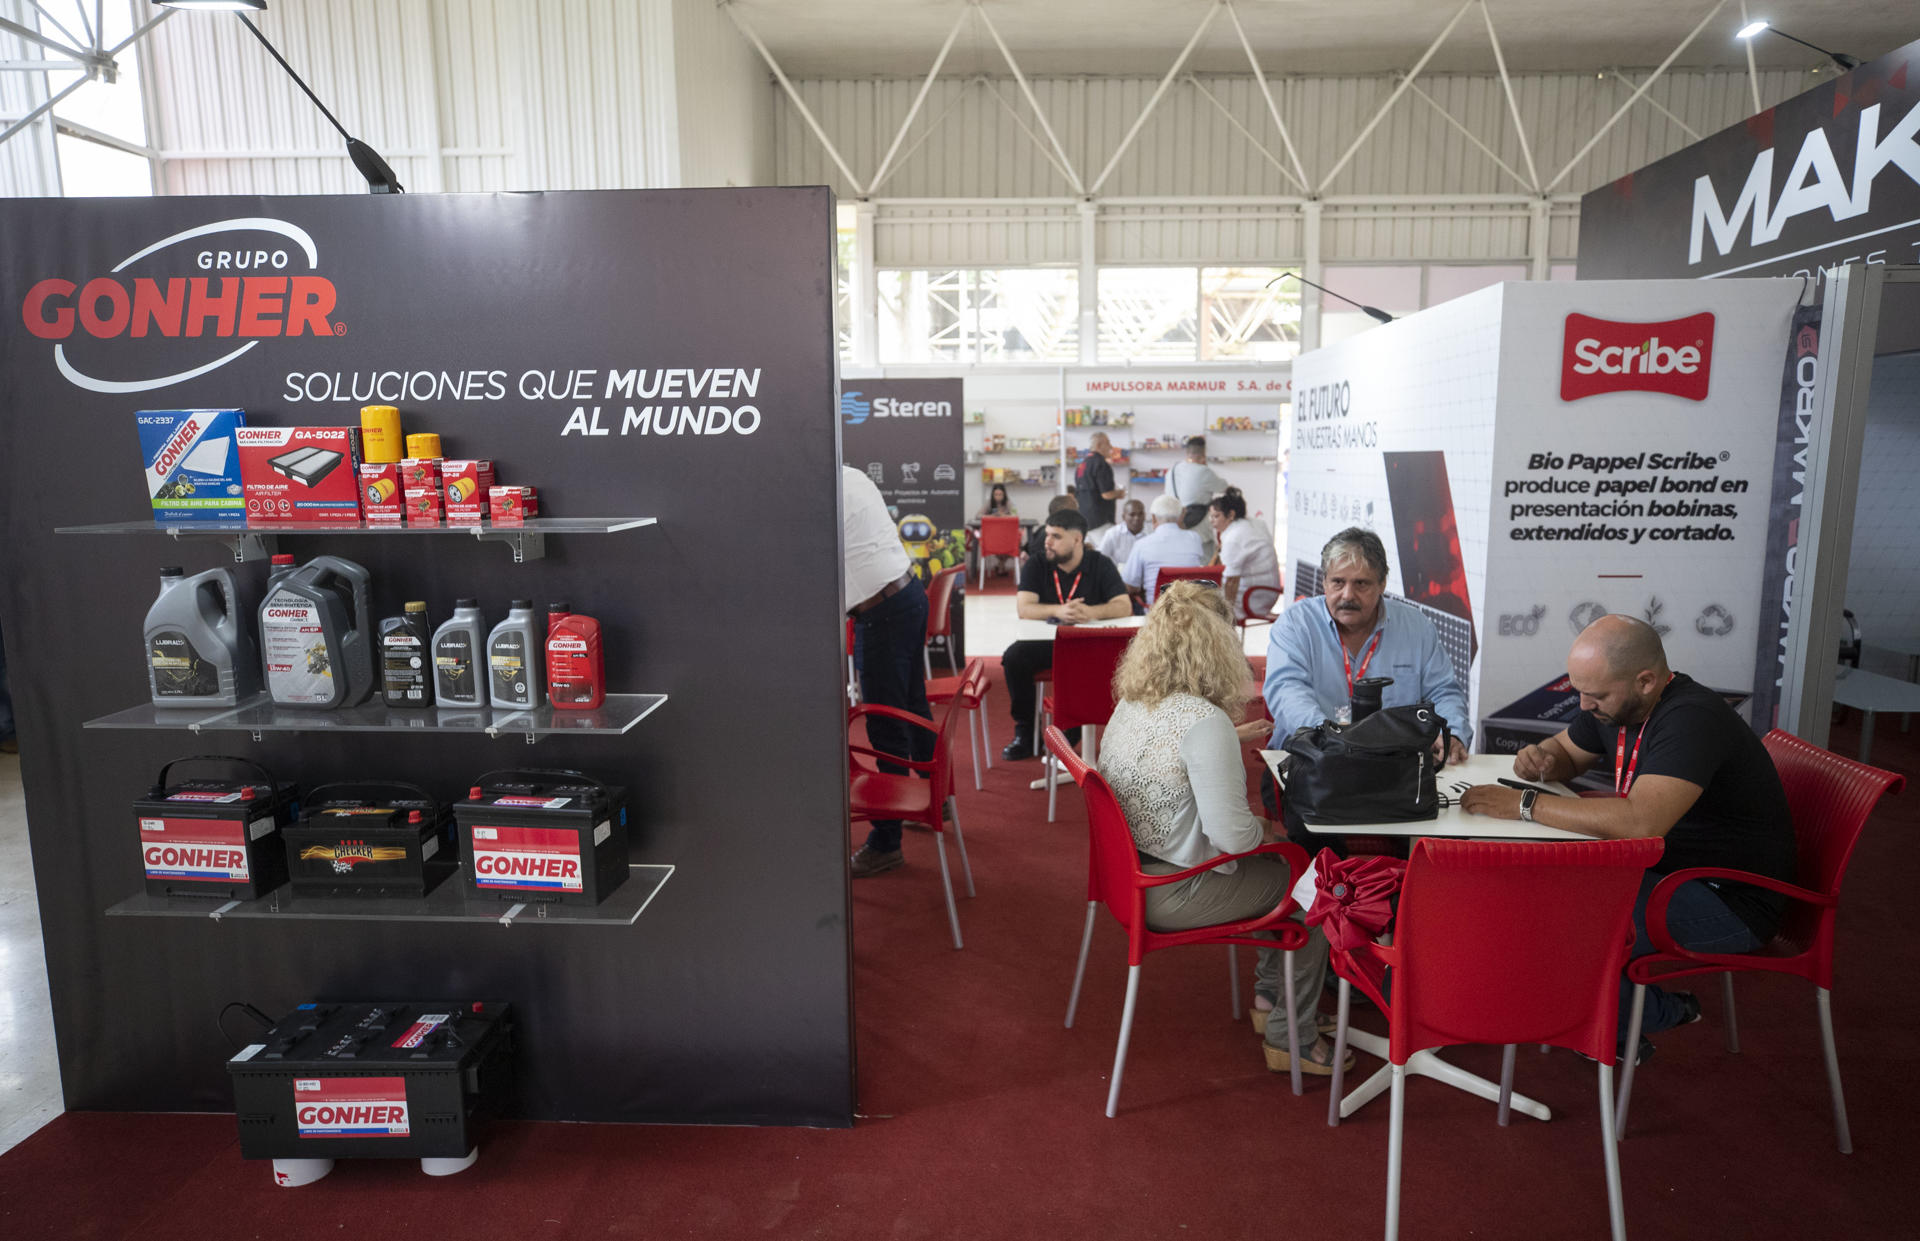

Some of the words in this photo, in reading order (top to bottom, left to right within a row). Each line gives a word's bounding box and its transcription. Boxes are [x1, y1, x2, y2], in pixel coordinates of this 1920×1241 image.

[197, 250, 288, 270] GRUPO
[283, 370, 507, 402] SOLUCIONES
[519, 369, 597, 400] QUE
[605, 368, 761, 398] MUEVEN
[1086, 381, 1162, 392] IMPULSORA
[1167, 381, 1227, 392] MARMUR
[1237, 380, 1261, 391] S.A.
[1266, 380, 1281, 391] de
[873, 398, 951, 418] Steren
[1298, 390, 1306, 421] EL
[1309, 379, 1350, 420] FUTURO
[138, 416, 174, 424] GAC-2337
[561, 407, 609, 436] AL
[621, 405, 761, 435] MUNDO
[238, 431, 281, 439] GONHER
[295, 431, 345, 439] GA-5022
[1307, 424, 1342, 449] NUESTRAS
[1344, 421, 1377, 449] MANOS
[155, 419, 200, 476] GONHER
[1528, 451, 1564, 470] Bio
[1568, 452, 1645, 474] Pappel
[1504, 477, 1590, 497] produce
[1595, 476, 1658, 497] papel
[1660, 476, 1719, 493] bond
[1721, 479, 1749, 493] en
[1510, 499, 1643, 520] presentación
[1647, 499, 1738, 519] bobinas,
[1510, 523, 1628, 541] extendidos
[1630, 527, 1646, 544] y
[1648, 524, 1735, 541] cortado.
[268, 609, 308, 617] GONHER
[1498, 614, 1539, 636] ECO
[145, 847, 244, 869] GONHER
[334, 845, 373, 859] CHECKER
[476, 855, 578, 878] GONHER
[298, 1106, 404, 1125] GONHER
